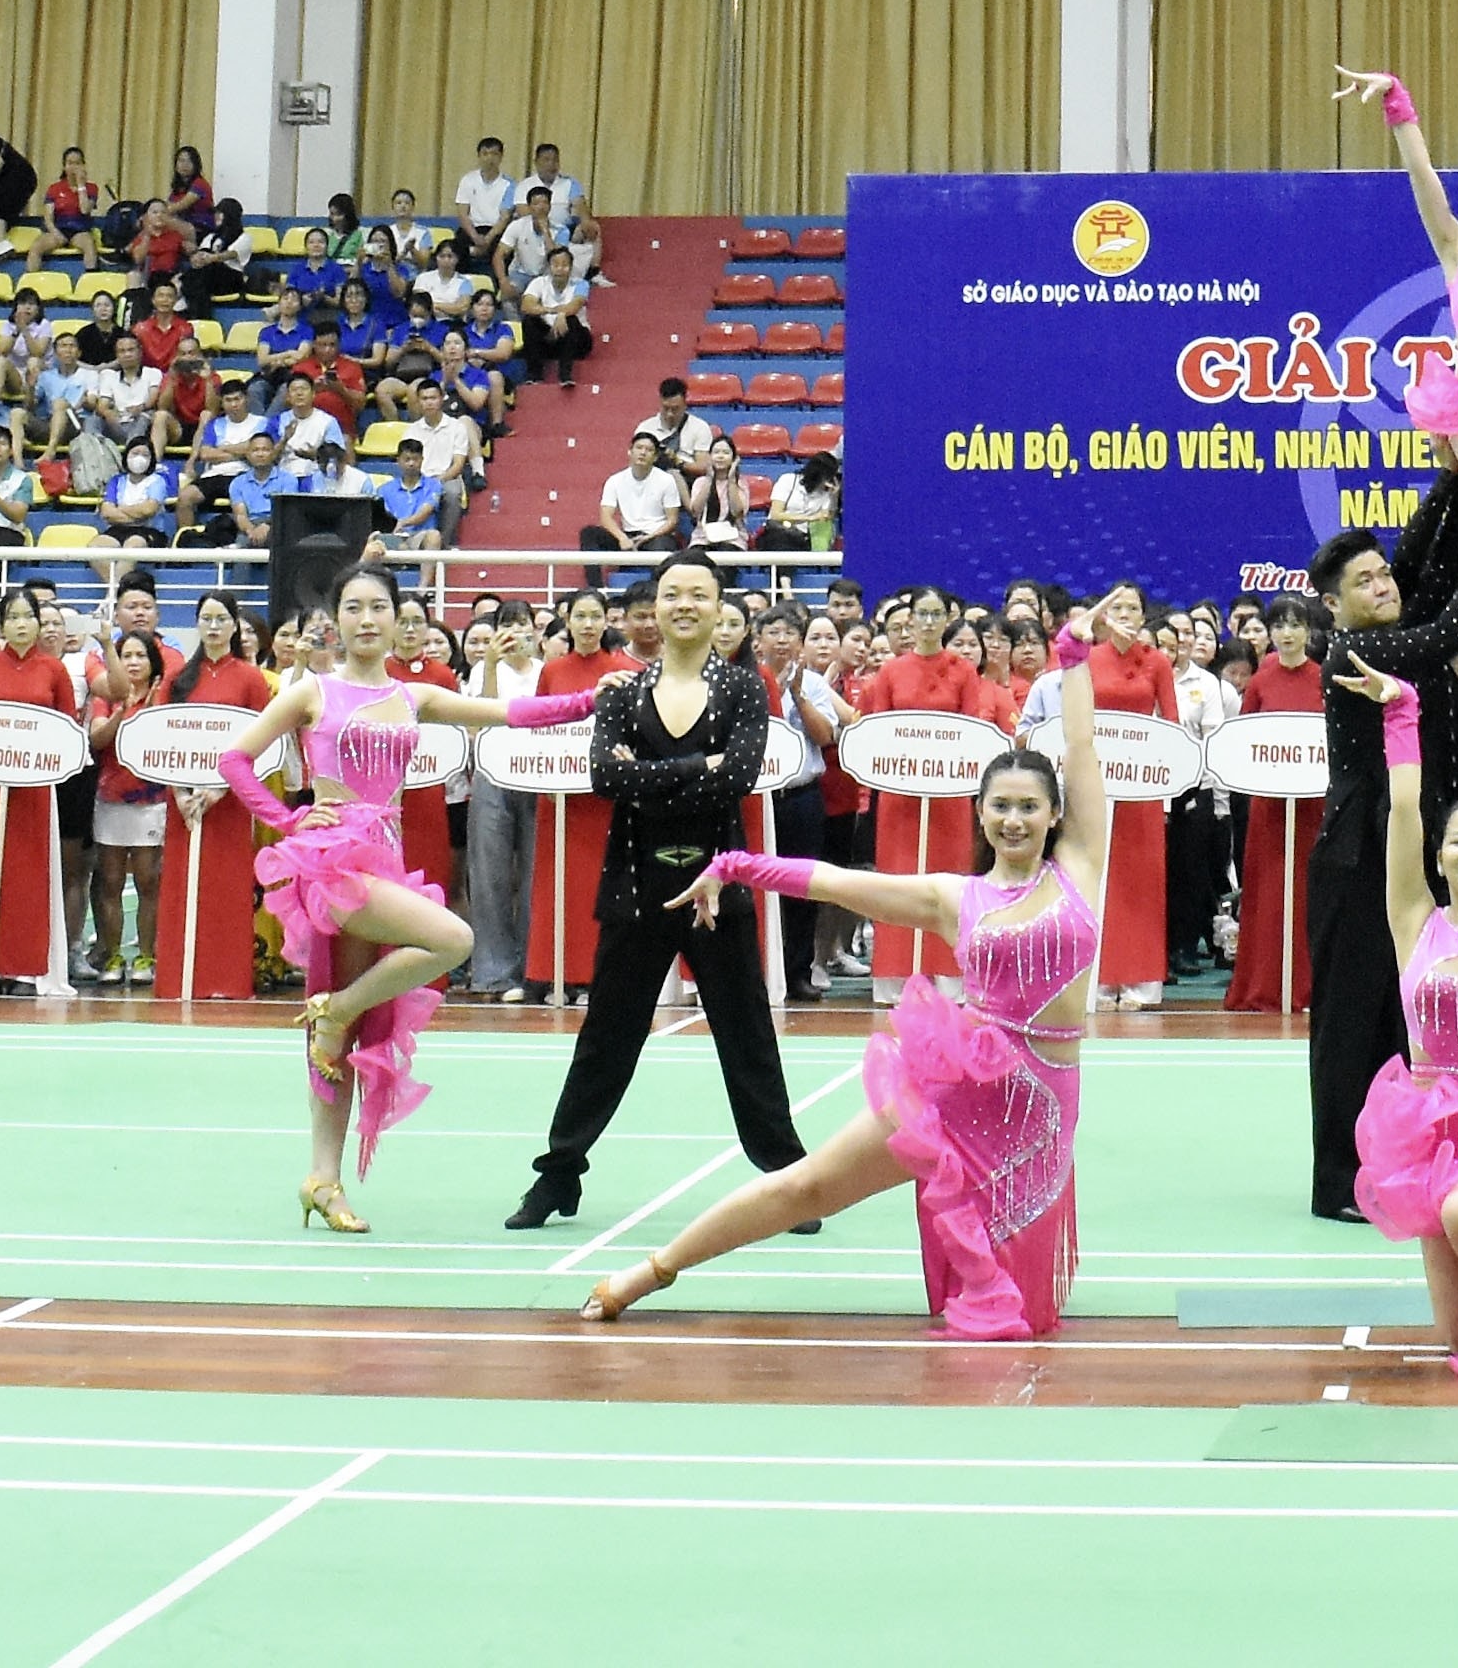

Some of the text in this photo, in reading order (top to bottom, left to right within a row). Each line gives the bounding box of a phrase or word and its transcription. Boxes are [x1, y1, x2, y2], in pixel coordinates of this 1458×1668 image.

[963, 279, 1259, 306] SỞ GIÁO DỤC VÀ ĐÀO TẠO HÀ NỘI
[1176, 312, 1377, 403] GIẢI
[946, 426, 1013, 469] CÁN
[1025, 425, 1077, 476] BỘ,
[1090, 425, 1167, 469] GIÁO
[1179, 424, 1263, 470] VIÊN,
[1276, 424, 1369, 467] NHÂN
[1340, 482, 1418, 527] NĂM
[1241, 563, 1286, 591] Từ
[34, 753, 60, 772] ANH
[143, 745, 185, 773] HUYỆN
[410, 754, 437, 773] SƠN
[510, 750, 587, 778] HUYỆN ỨNG
[872, 754, 978, 780] HUYỆN GIA LÂM
[1250, 739, 1326, 768] TRỌNG TÀ
[1106, 756, 1138, 782] HOÀI
[1144, 758, 1170, 786] ĐỨC
